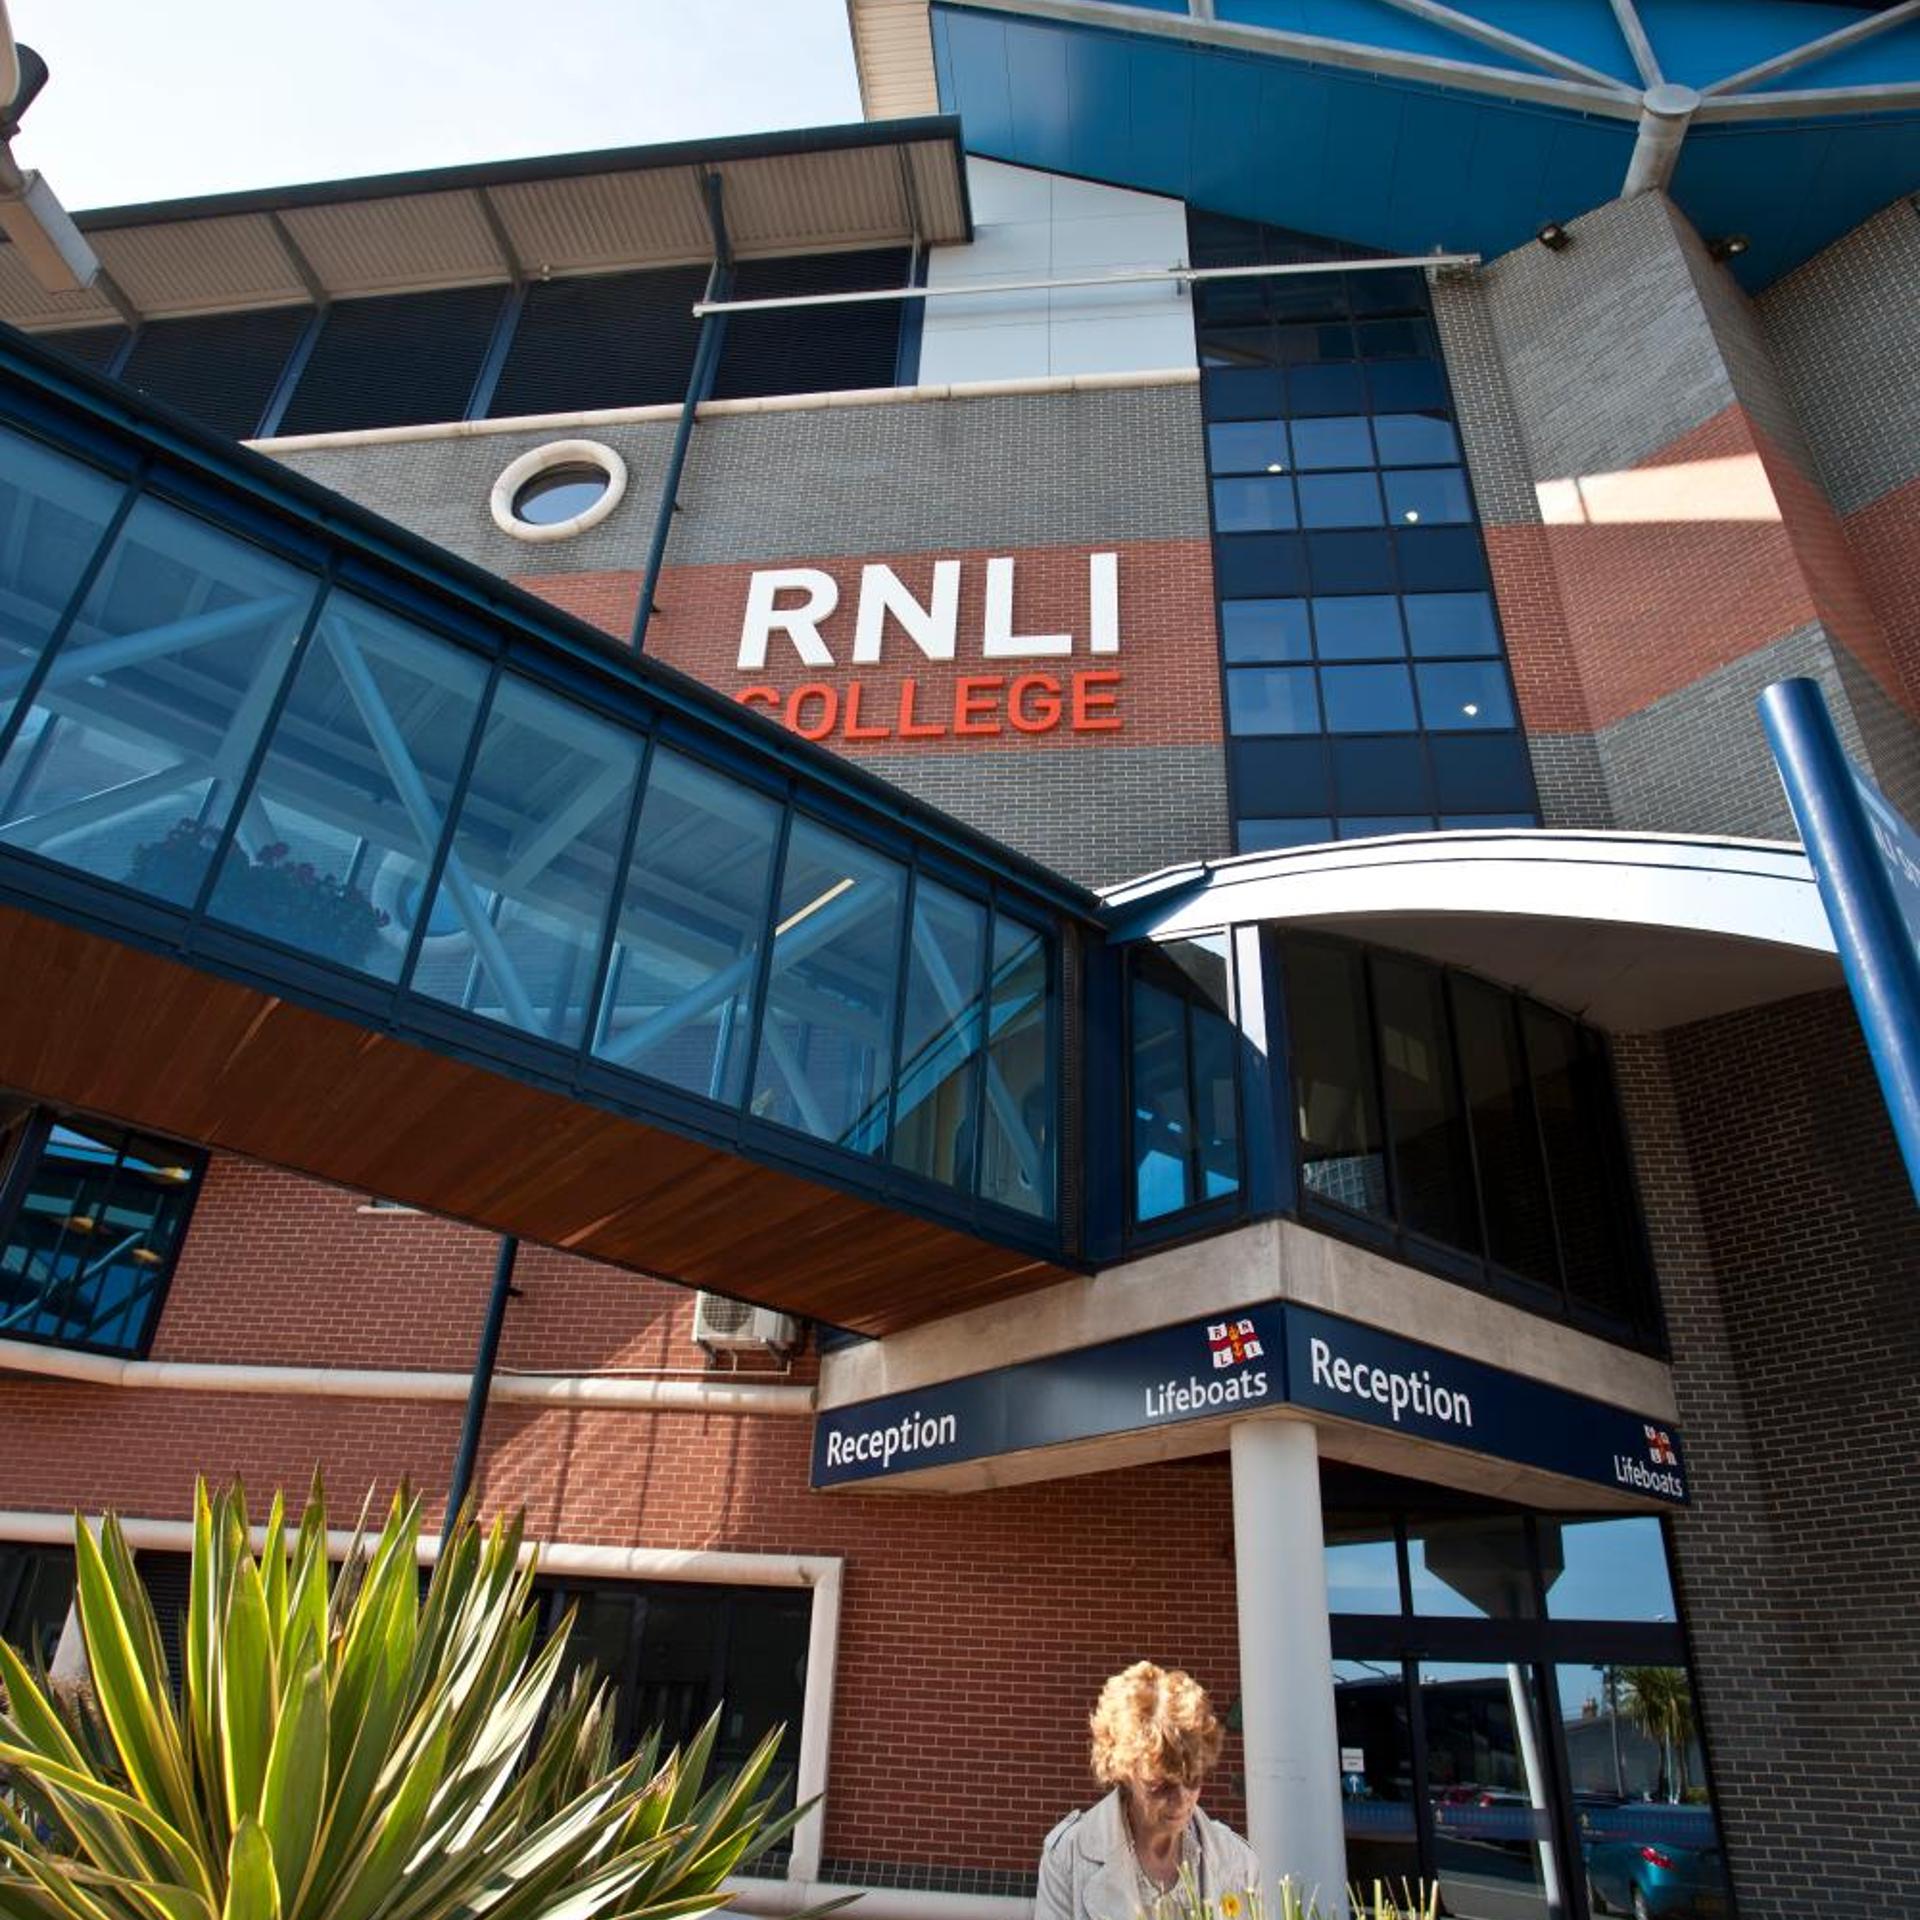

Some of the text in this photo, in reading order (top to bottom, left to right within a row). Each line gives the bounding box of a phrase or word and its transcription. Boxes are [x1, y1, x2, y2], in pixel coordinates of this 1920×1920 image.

[737, 552, 1120, 670] RNLI
[1145, 1369, 1268, 1417] Lifeboats
[1311, 1337, 1473, 1427] Reception
[826, 1410, 956, 1467] Reception
[1613, 1454, 1683, 1497] Lifeboats
